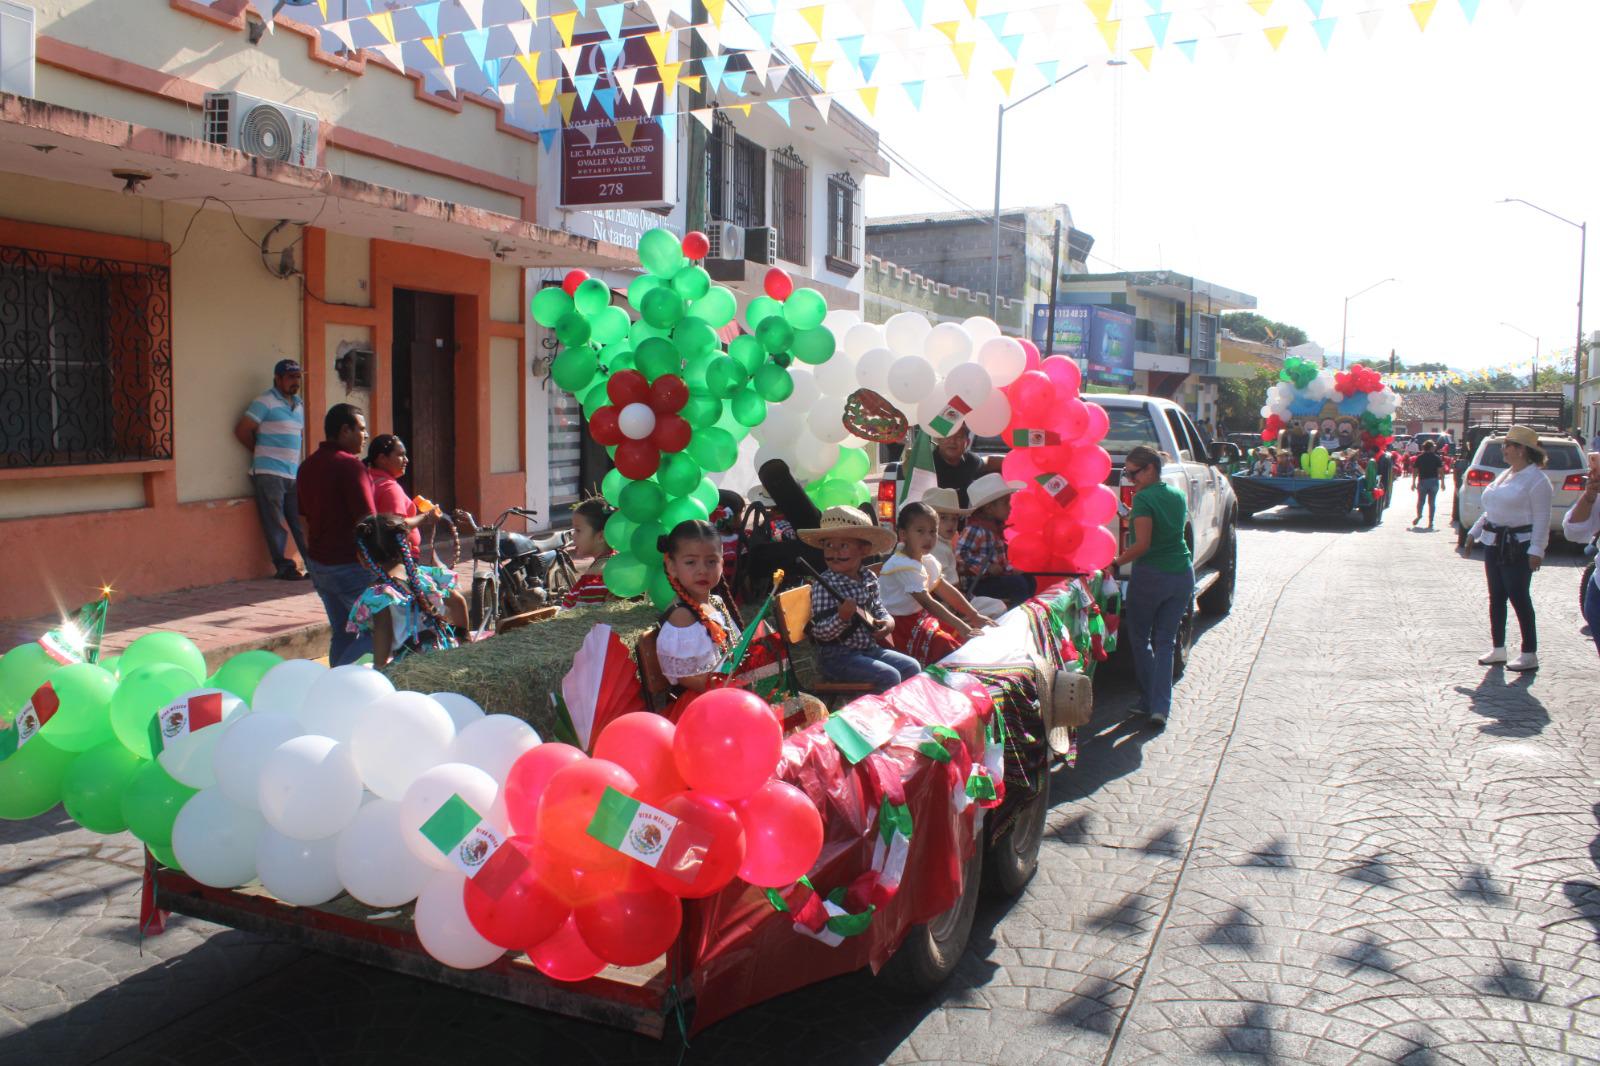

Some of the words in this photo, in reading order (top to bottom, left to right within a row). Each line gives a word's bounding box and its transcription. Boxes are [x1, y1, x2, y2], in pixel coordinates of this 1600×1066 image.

[570, 150, 584, 158] LIC.
[586, 148, 616, 157] RAFAEL
[617, 145, 654, 155] ALFONSO
[577, 159, 607, 167] OVALLE
[609, 155, 646, 165] VÁZQUEZ
[599, 183, 624, 196] 278
[638, 811, 652, 820] VIVA
